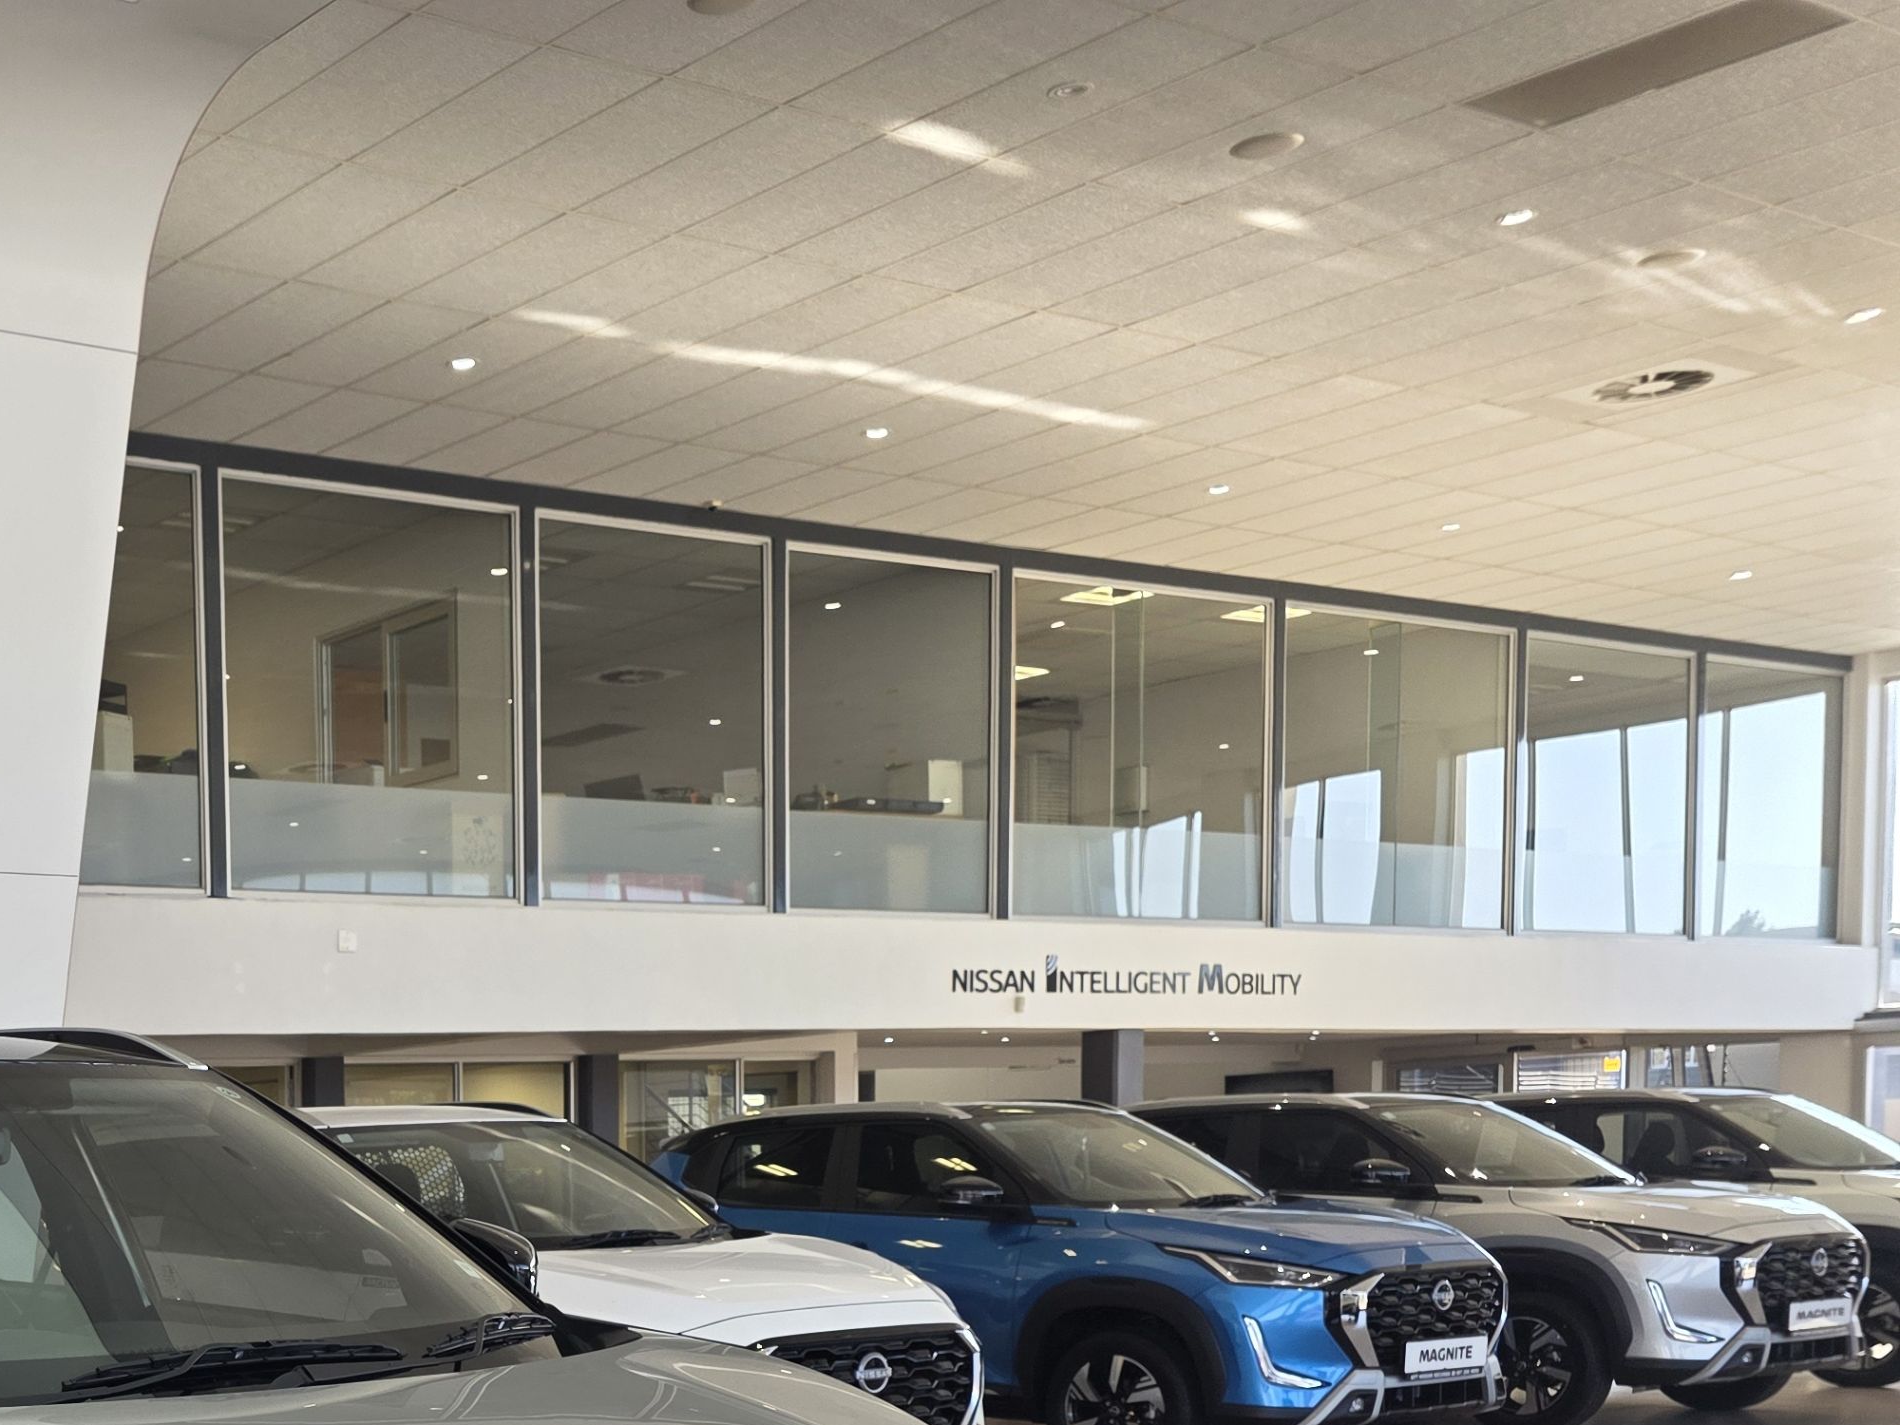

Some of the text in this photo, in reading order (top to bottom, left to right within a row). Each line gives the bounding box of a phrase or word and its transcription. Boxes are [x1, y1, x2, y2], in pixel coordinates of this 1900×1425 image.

[951, 954, 1302, 996] NISSAN INTELLIGENT MOBILITY
[1796, 1307, 1845, 1320] MAGNITE
[1419, 1345, 1473, 1364] MAGNITE
